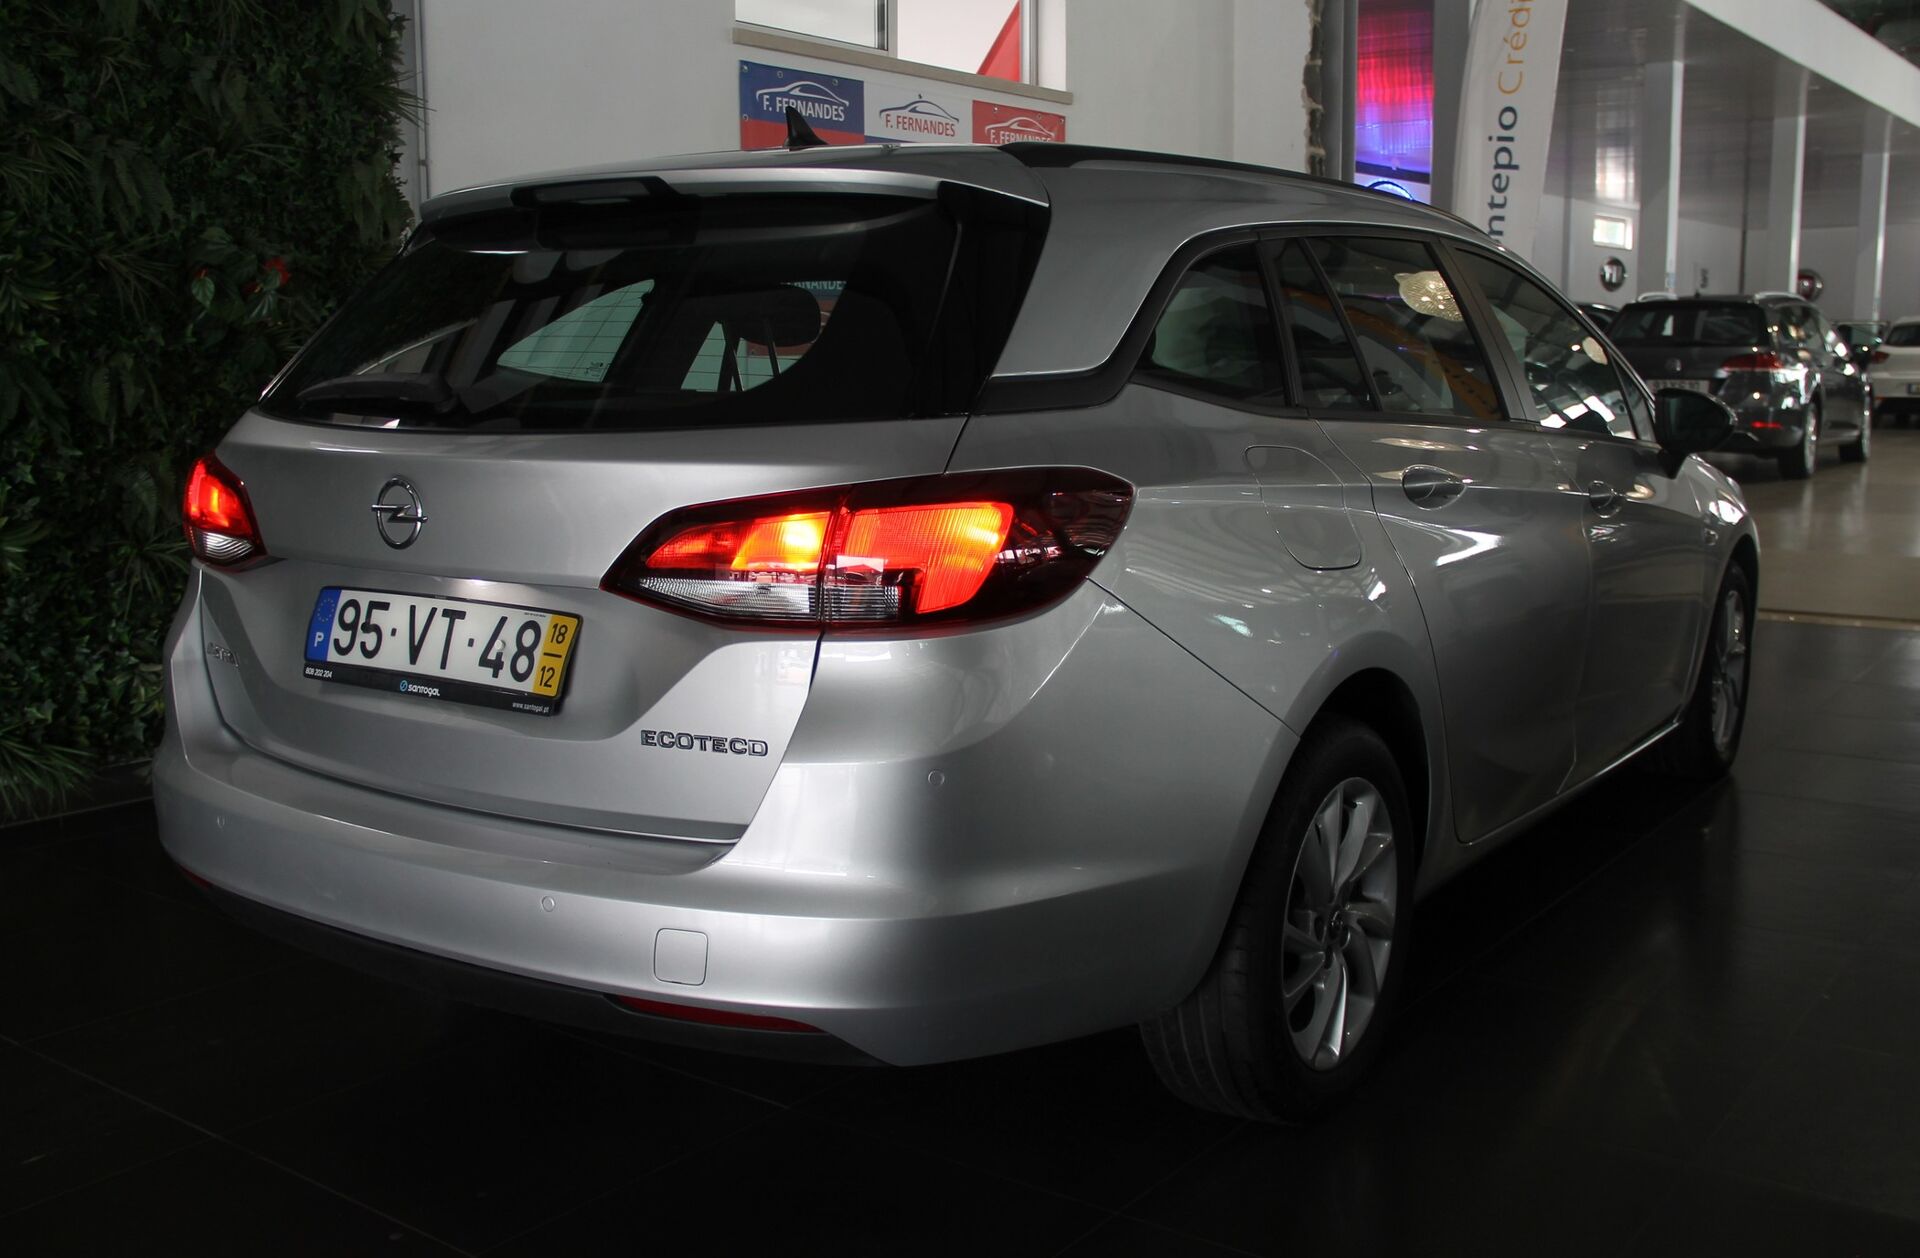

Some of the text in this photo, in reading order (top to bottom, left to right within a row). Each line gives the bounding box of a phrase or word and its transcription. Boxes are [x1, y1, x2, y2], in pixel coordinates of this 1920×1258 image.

[762, 95, 772, 112] F.
[885, 113, 956, 137] F. FERNANDES
[990, 129, 998, 143] F.
[1487, 105, 1519, 241] ntepio
[314, 631, 325, 647] P
[550, 622, 568, 645] 18
[314, 668, 324, 677] 202
[323, 670, 333, 679] 204
[539, 665, 554, 688] 12
[408, 683, 441, 697] santogal
